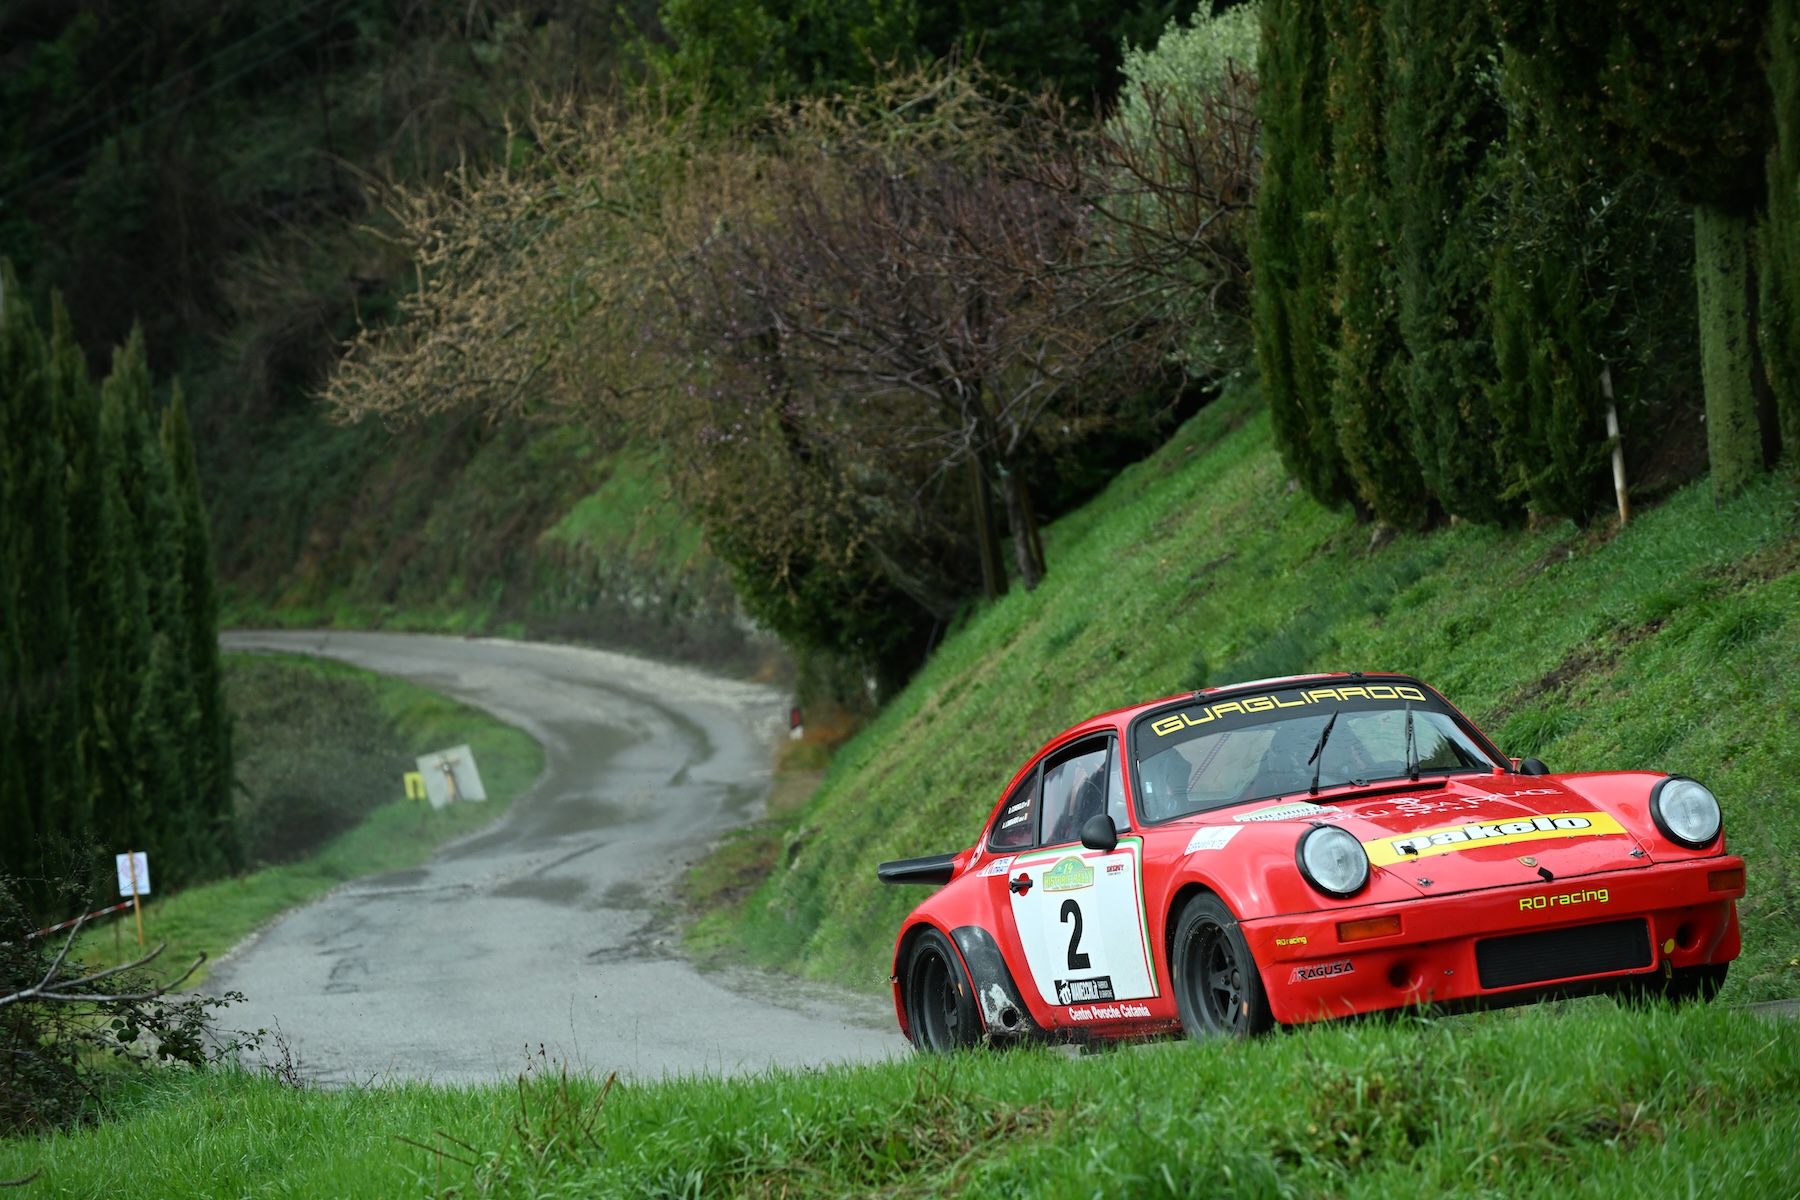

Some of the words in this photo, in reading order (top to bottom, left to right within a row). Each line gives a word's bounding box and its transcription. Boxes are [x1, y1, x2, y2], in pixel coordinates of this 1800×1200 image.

[1151, 686, 1427, 736] GUAGLIARDO
[1391, 817, 1592, 856] pakelo
[1044, 874, 1071, 889] HISTORIC
[1073, 869, 1093, 883] RALLY
[1519, 897, 1547, 911] RO
[1549, 888, 1609, 907] racing
[1060, 899, 1091, 970] 2
[1068, 1007, 1093, 1021] Centro
[1091, 1004, 1121, 1019] Porsche
[1120, 1002, 1151, 1018] Catania
